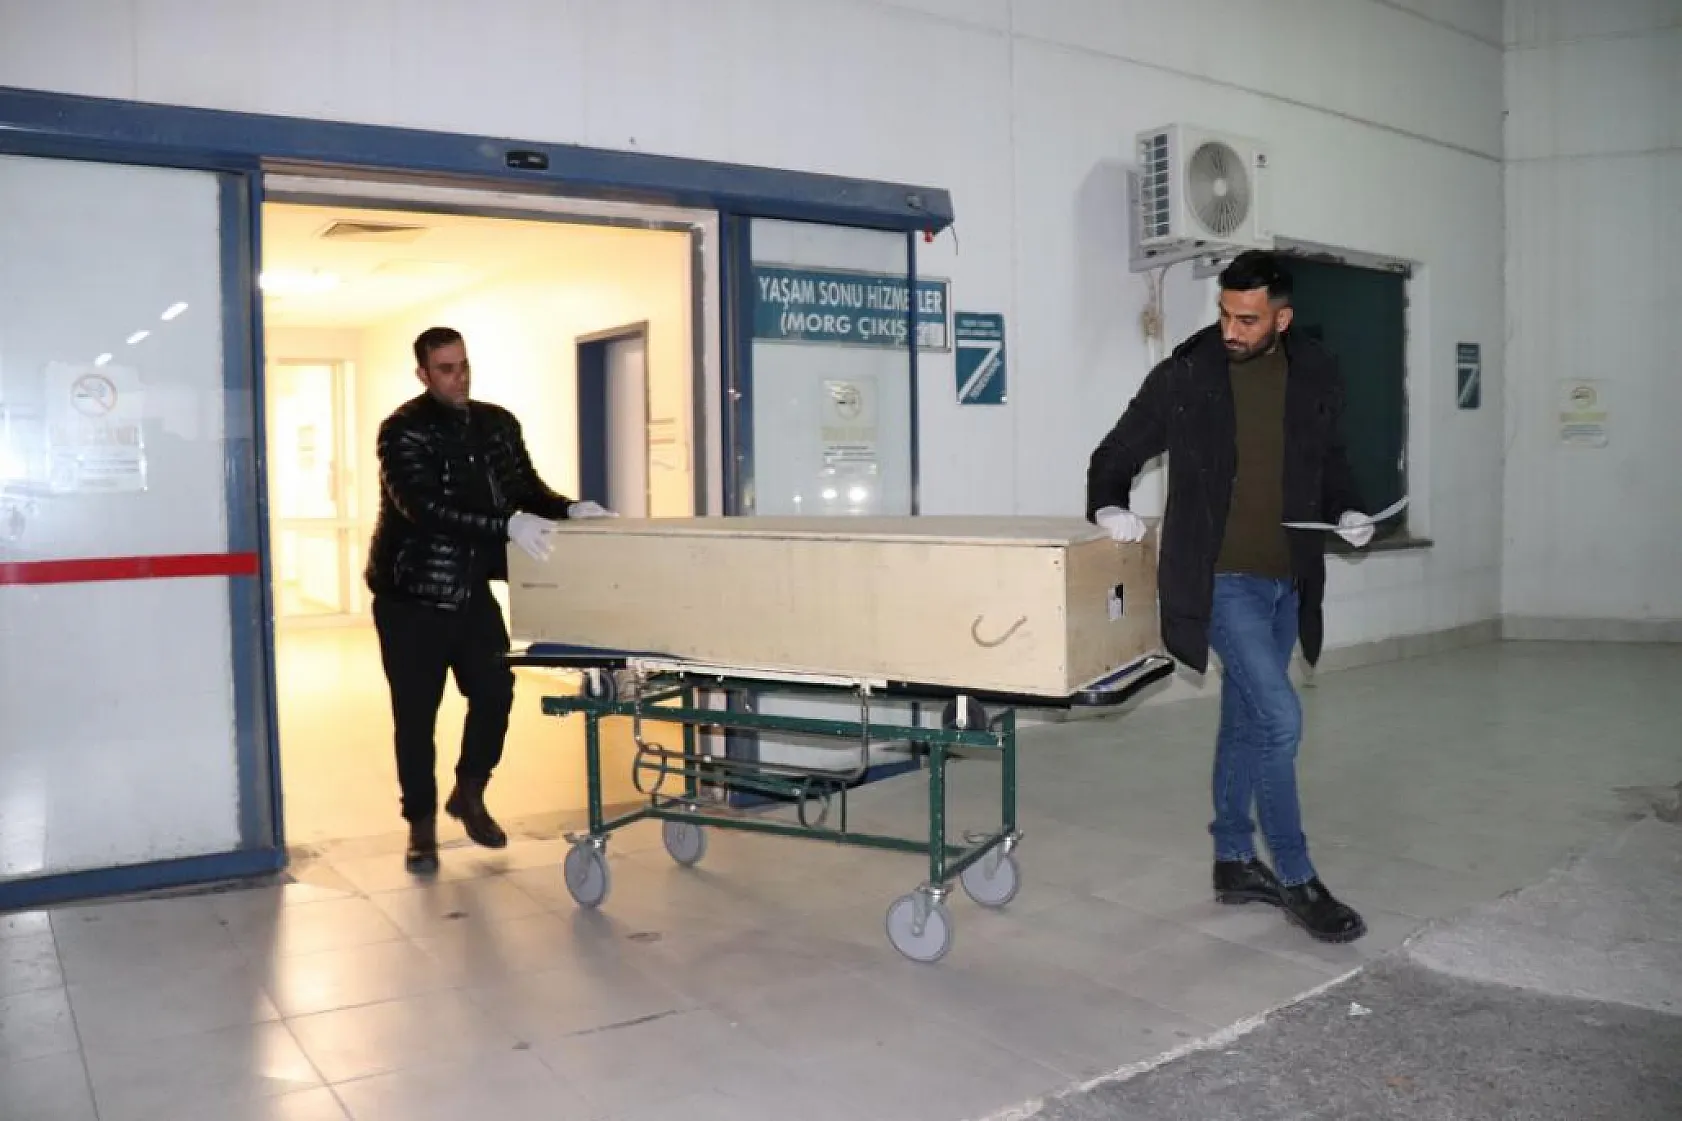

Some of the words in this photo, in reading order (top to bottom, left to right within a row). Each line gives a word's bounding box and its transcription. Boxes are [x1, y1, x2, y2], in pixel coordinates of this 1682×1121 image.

[758, 275, 815, 309] YAŞAM
[819, 281, 862, 308] SONU
[781, 311, 850, 336] (MORG
